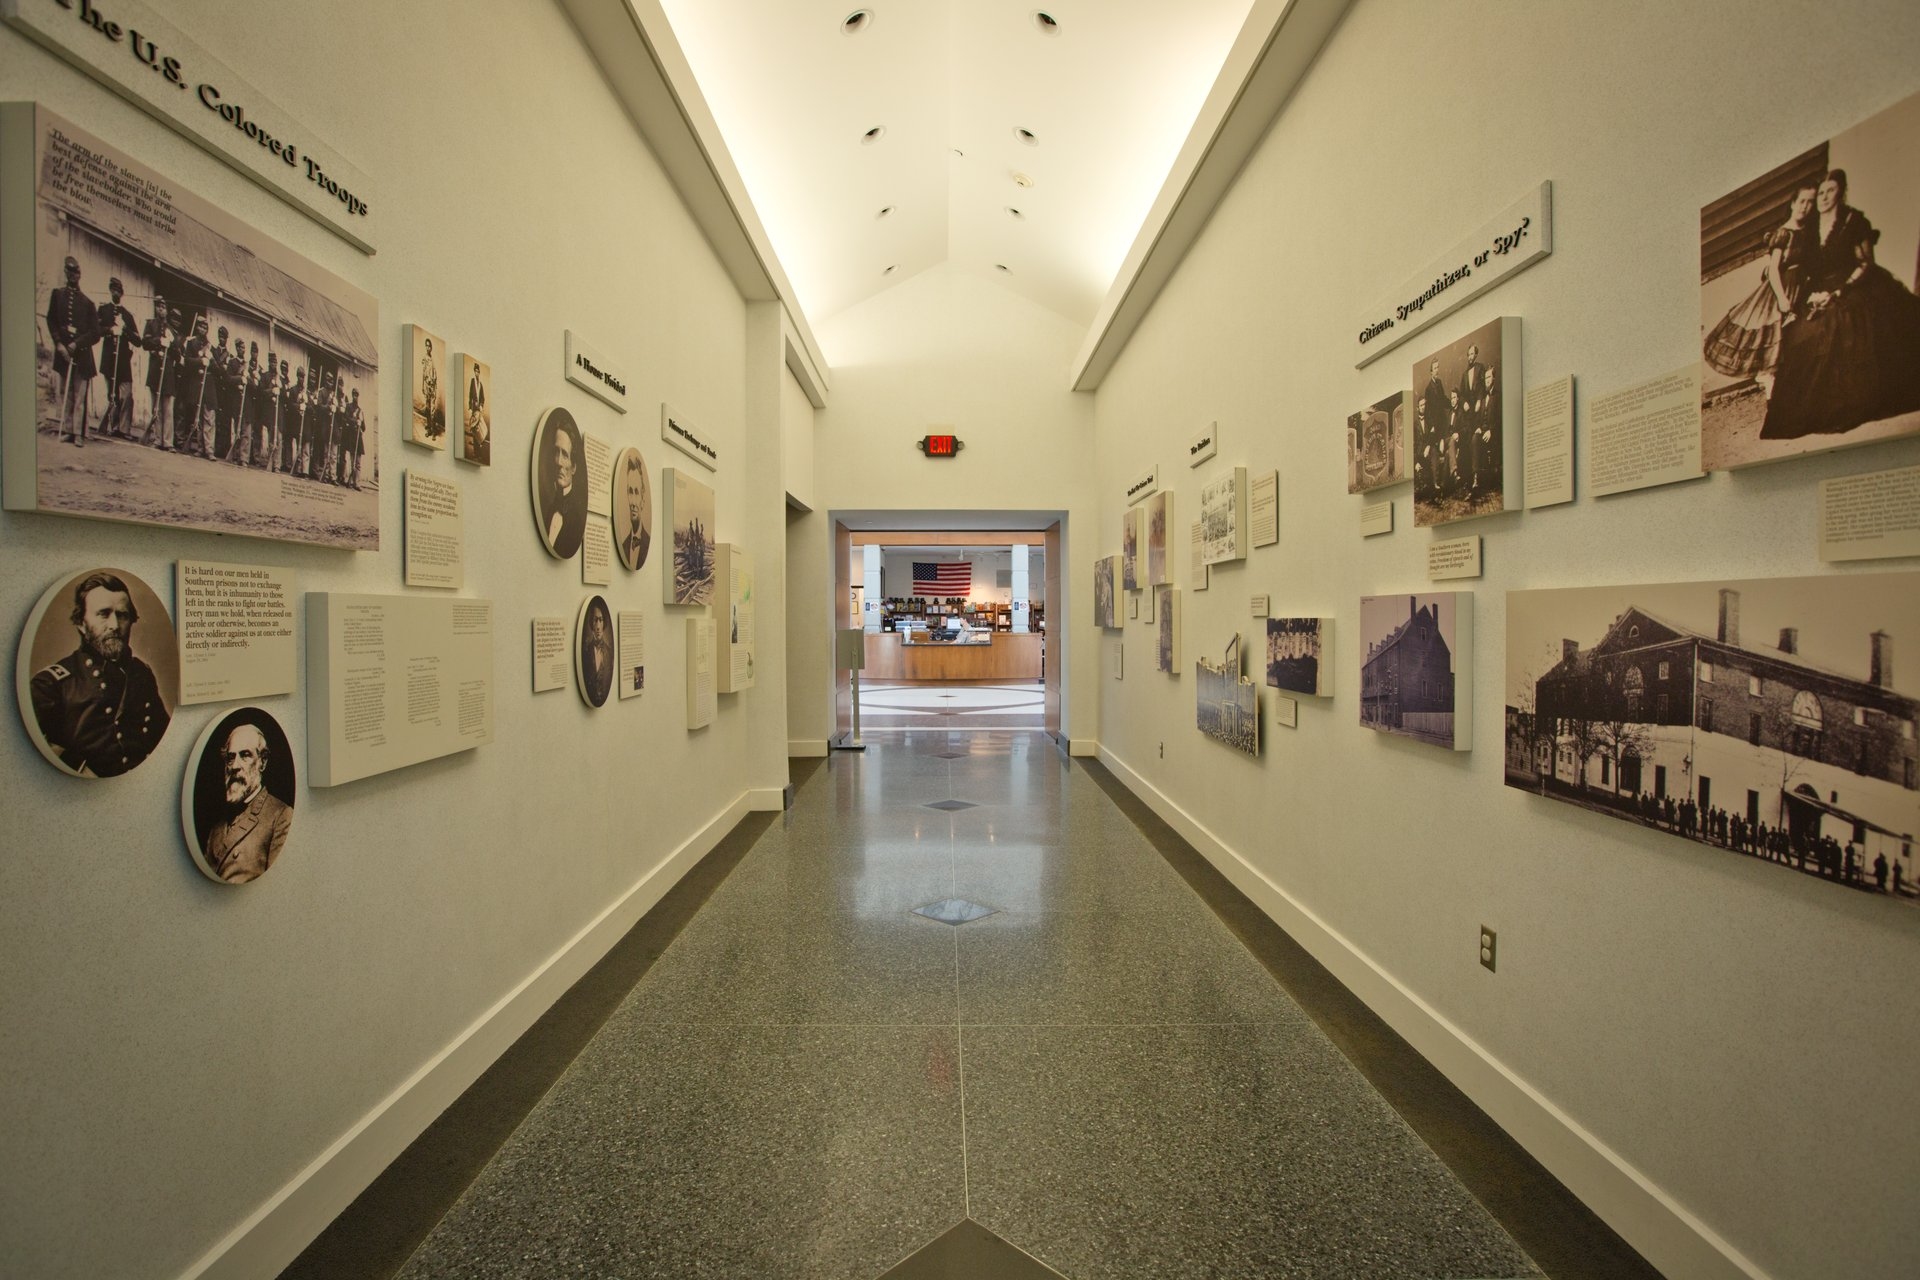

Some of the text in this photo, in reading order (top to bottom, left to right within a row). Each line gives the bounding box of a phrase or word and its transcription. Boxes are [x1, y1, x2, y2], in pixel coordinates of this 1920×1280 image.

[54, 0, 368, 217] he U.S. Colored Troops
[52, 128, 69, 144] The
[72, 142, 91, 157] arm
[93, 153, 104, 165] of
[104, 159, 118, 170] the
[120, 168, 144, 186] slaves
[160, 189, 172, 200] the
[52, 141, 171, 211] best defense against the arm
[52, 180, 68, 193] the
[52, 156, 64, 168] of
[64, 161, 80, 175] the
[153, 208, 177, 225] would
[52, 166, 64, 178] be
[86, 183, 131, 213] themselves
[133, 209, 153, 224] must
[154, 220, 176, 236] strike
[1359, 217, 1530, 345] Citizen, Sympathizer, or Spy?
[576, 353, 582, 366] A
[604, 372, 626, 396] Divided
[930, 436, 952, 453] EXIT
[185, 566, 190, 574] It
[192, 567, 197, 575] is
[199, 567, 213, 576] hard
[250, 570, 262, 579] held
[264, 571, 269, 579] in
[185, 577, 214, 586] Southern
[216, 579, 238, 588] prisons
[257, 581, 282, 591] exchange
[185, 587, 203, 597] them,
[205, 588, 215, 597] but
[217, 588, 221, 596] it
[223, 589, 228, 597] is
[229, 589, 261, 600] inhumanity
[269, 590, 283, 599] those
[185, 598, 196, 607] left
[198, 598, 204, 606] in
[206, 599, 216, 607] the
[217, 599, 234, 607] ranks
[243, 599, 255, 609] fight
[185, 609, 203, 618] Every
[246, 609, 261, 617] when
[185, 619, 206, 630] parole
[247, 619, 271, 627] becomes
[185, 630, 204, 638] active
[206, 629, 227, 638] soldier
[228, 630, 248, 639] against
[277, 628, 292, 636] either
[185, 641, 210, 650] directly
[220, 639, 250, 649] indirectly.
